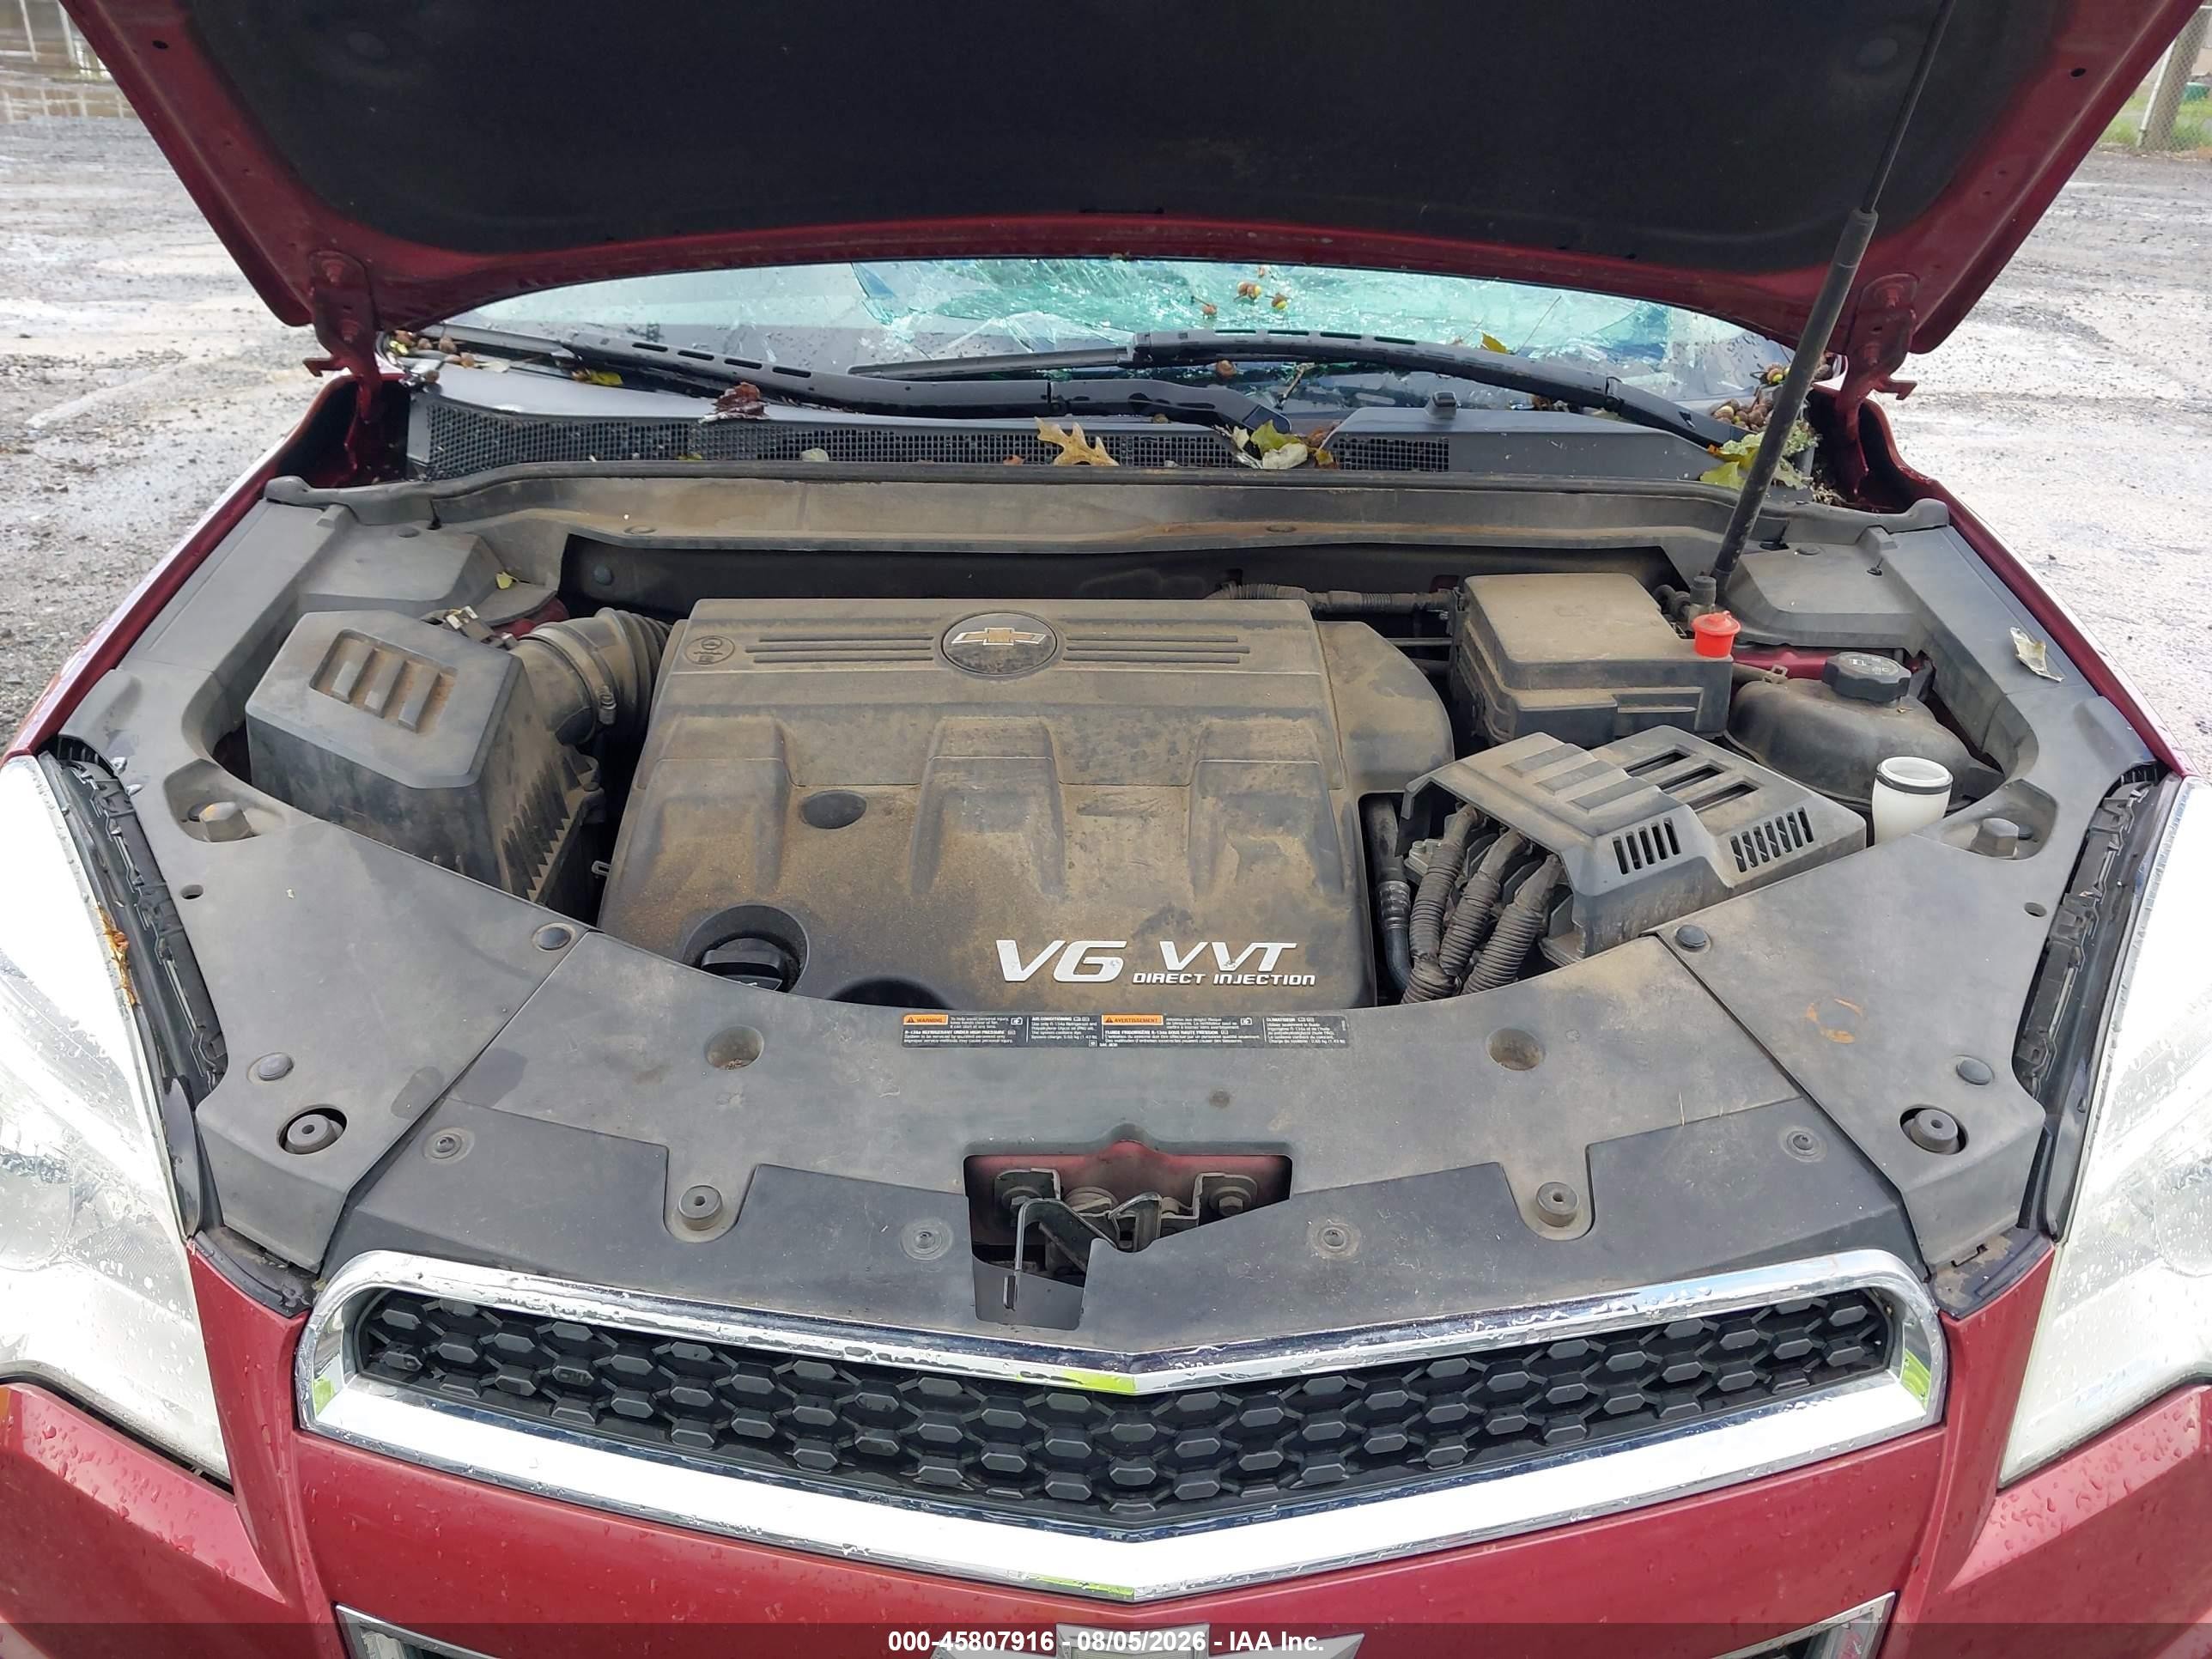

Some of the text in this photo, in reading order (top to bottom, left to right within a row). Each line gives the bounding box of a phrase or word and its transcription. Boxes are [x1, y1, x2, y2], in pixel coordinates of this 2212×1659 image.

[996, 939, 1297, 982] V6 VVT
[1132, 973, 1316, 987] DIRECT INJECTION
